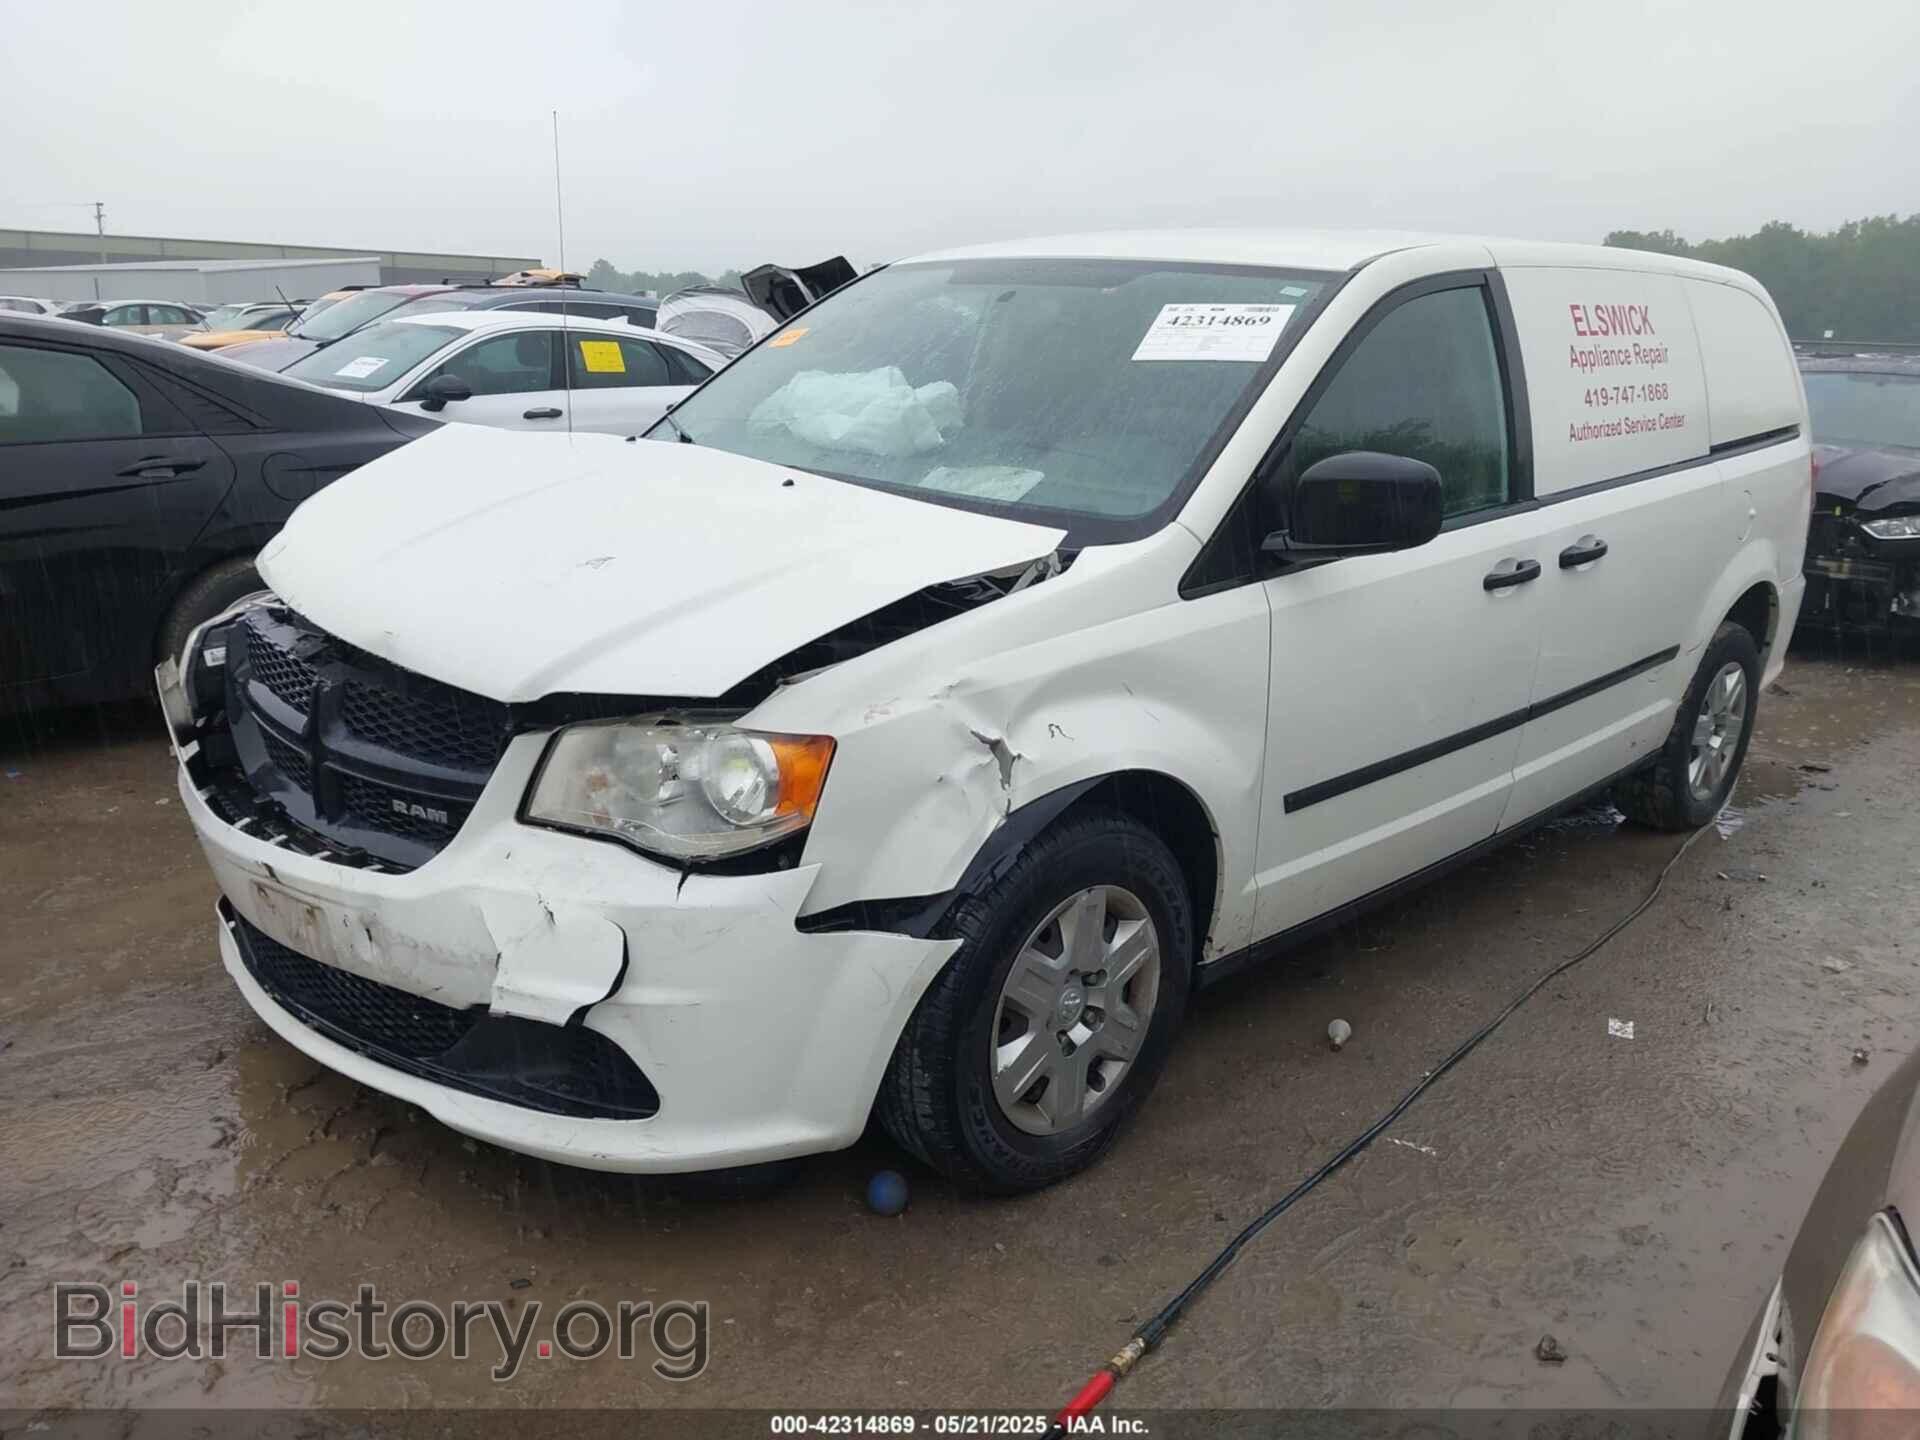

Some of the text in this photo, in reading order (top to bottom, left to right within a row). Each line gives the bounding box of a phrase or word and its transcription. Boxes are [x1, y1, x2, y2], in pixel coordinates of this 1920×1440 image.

[1167, 315, 1271, 326] 42314869
[1569, 304, 1655, 336] ELSWICK
[1570, 342, 1668, 374] Appliance Repair
[1584, 383, 1669, 407] 419-747-1868
[1569, 412, 1685, 442] Authorized Service Center
[392, 799, 448, 824] RAM
